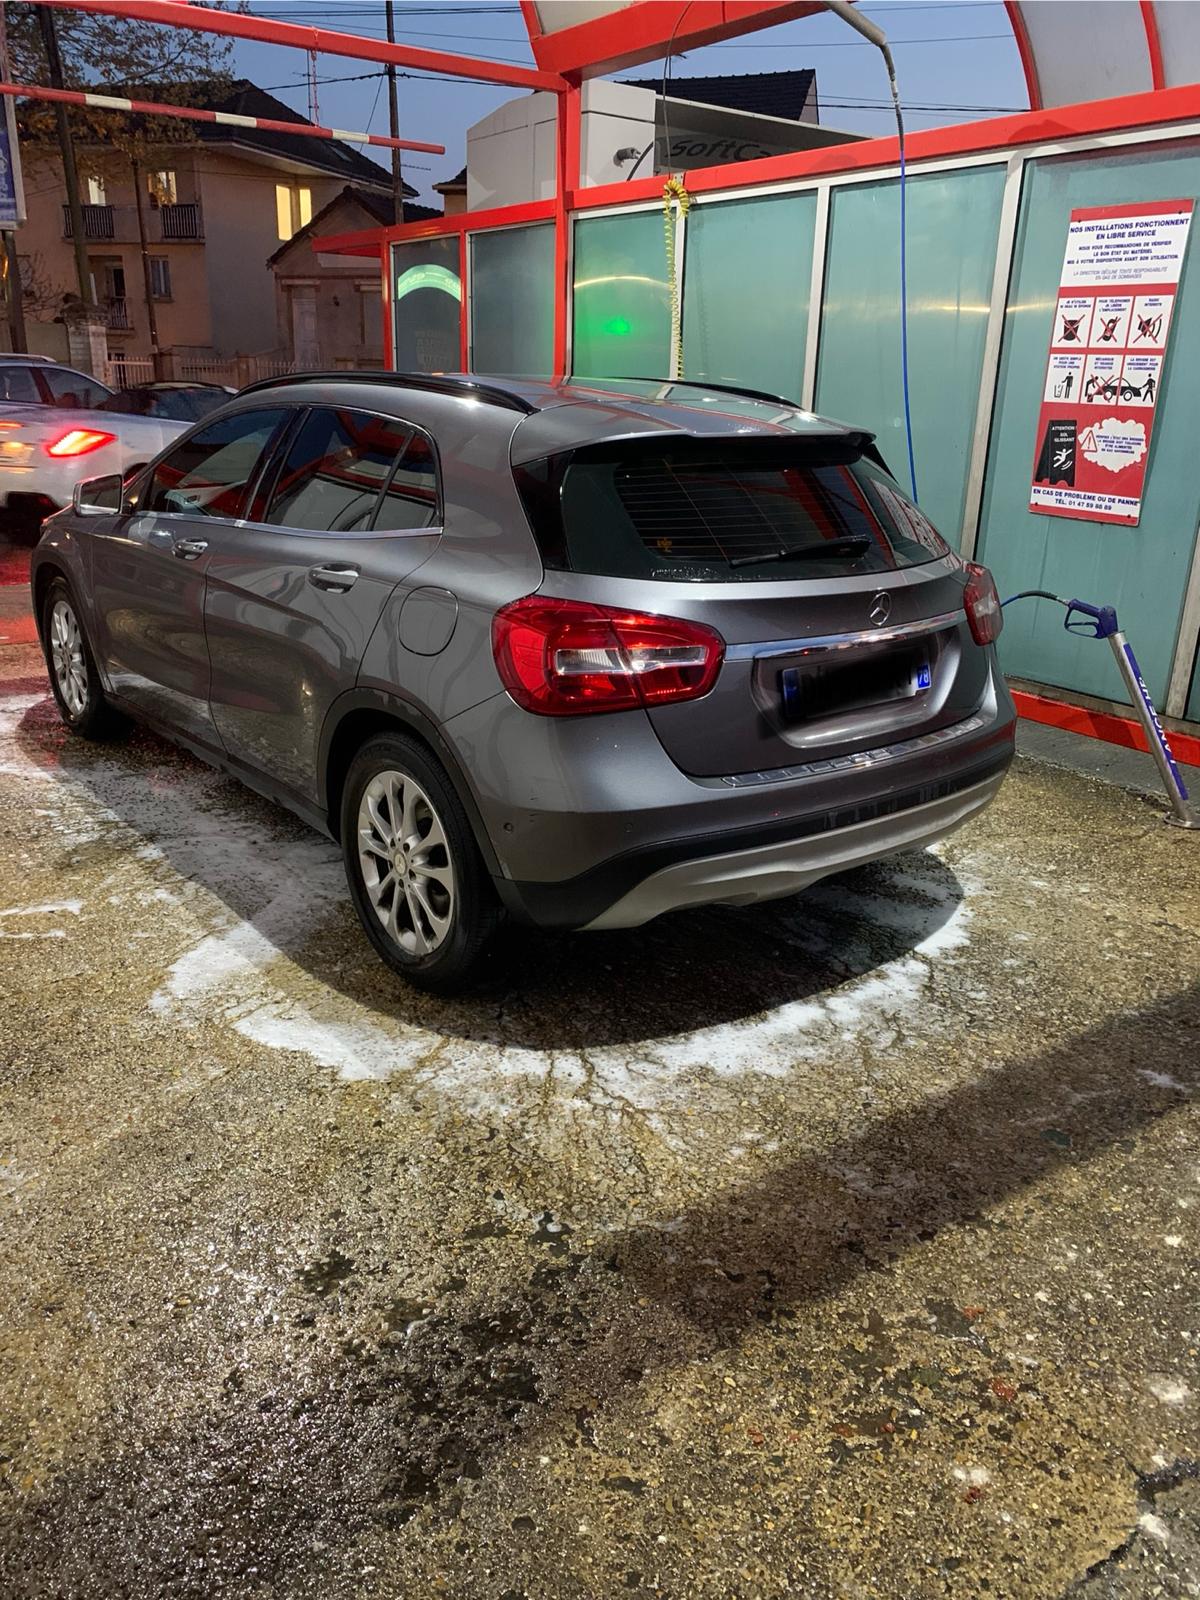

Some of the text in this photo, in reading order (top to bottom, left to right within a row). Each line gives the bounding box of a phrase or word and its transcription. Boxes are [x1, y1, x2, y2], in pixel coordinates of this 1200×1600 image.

[1084, 222, 1133, 232] INSTALLATIONS
[1135, 218, 1189, 228] FONCTIONNENT
[1106, 231, 1126, 239] LIBRE
[1127, 229, 1156, 238] SERVICE
[1117, 498, 1138, 506] PANNE
